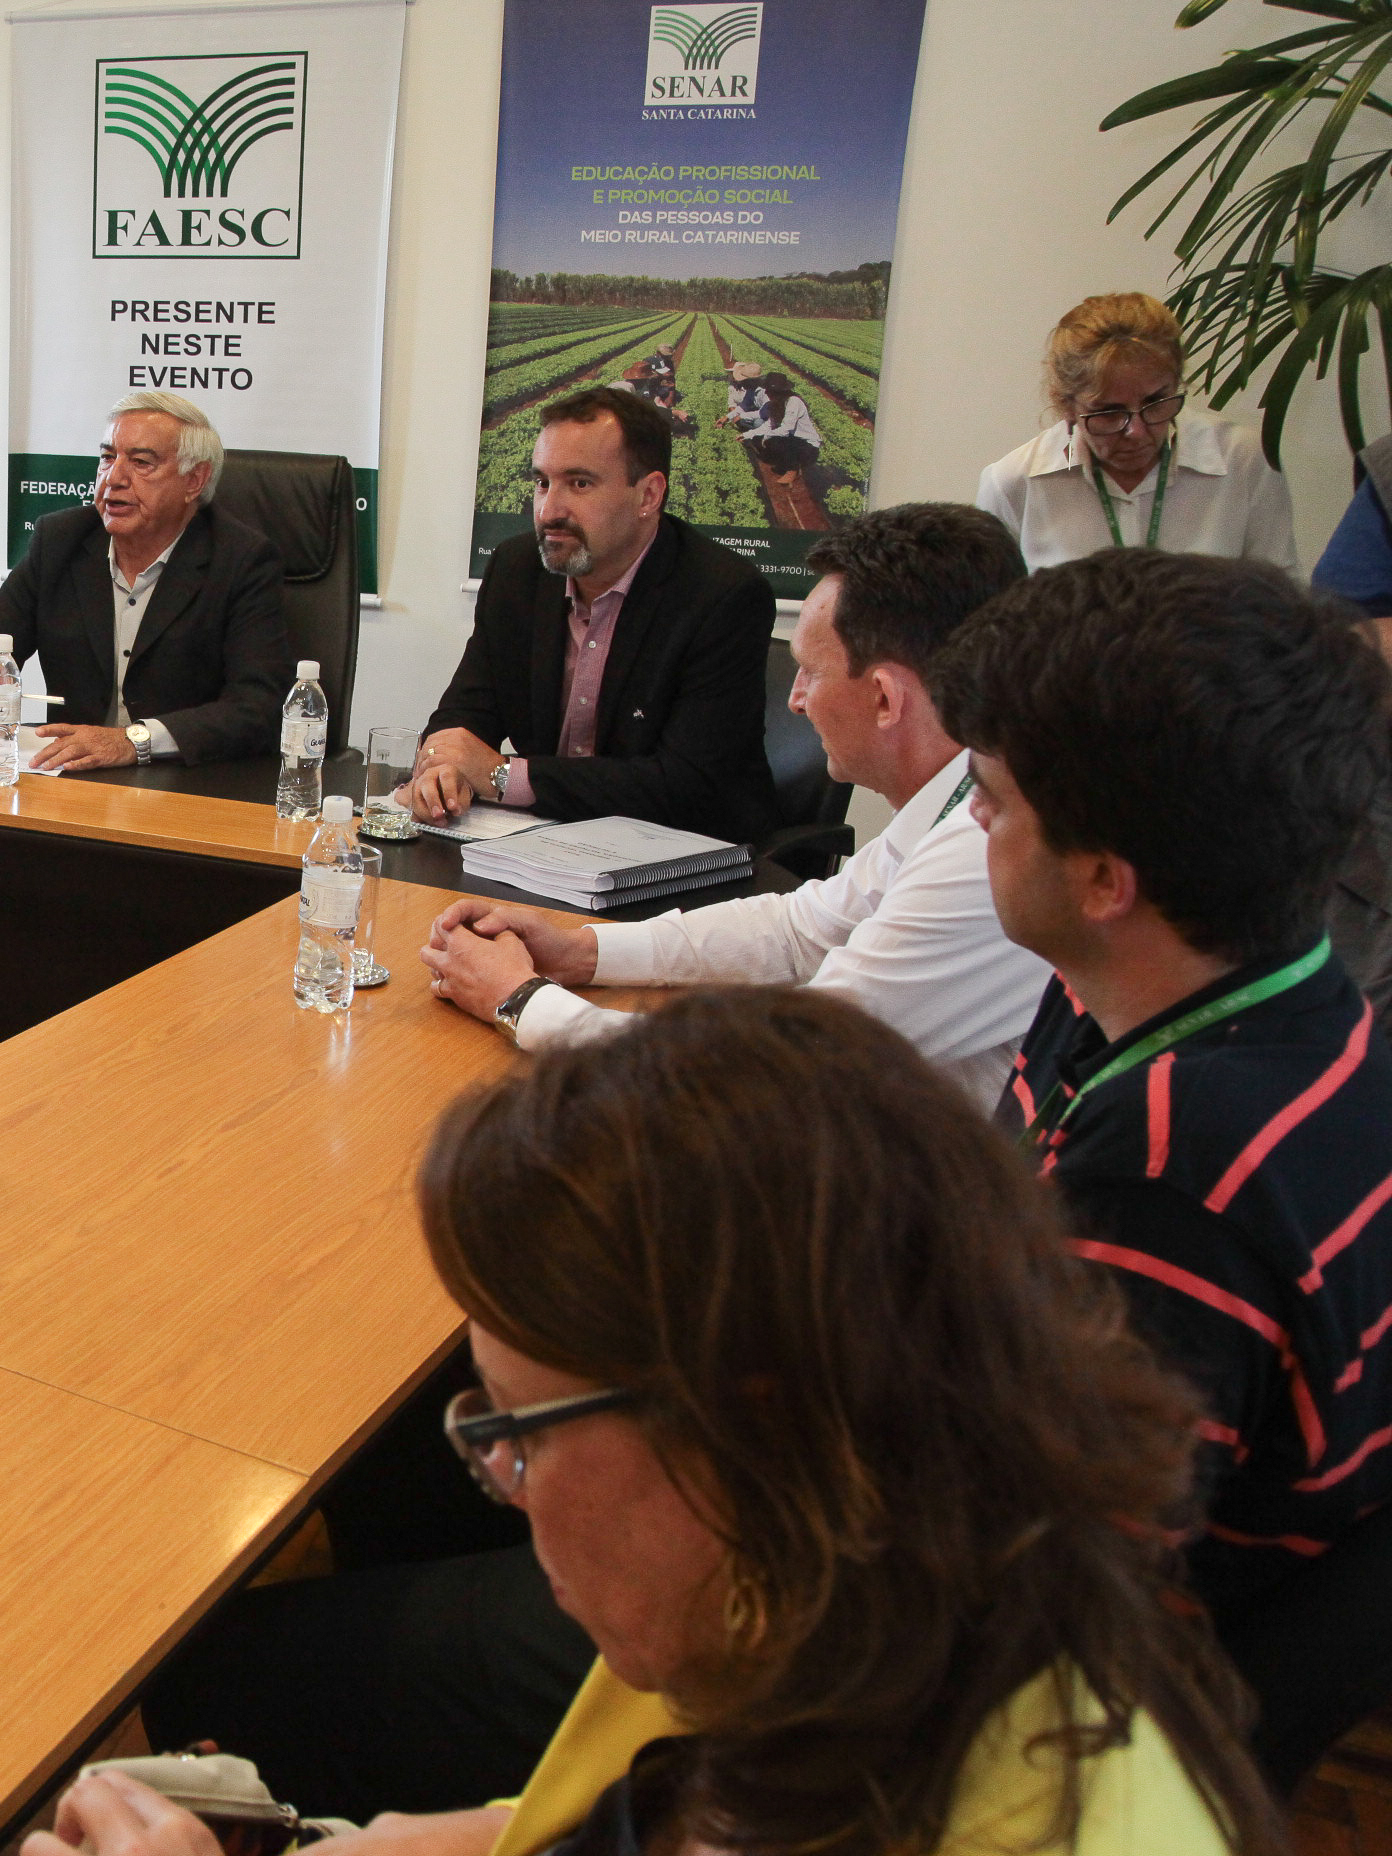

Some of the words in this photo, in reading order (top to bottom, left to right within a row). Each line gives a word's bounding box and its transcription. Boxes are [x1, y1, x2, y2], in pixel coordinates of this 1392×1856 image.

[651, 75, 749, 99] SENAR
[642, 109, 685, 120] SANTA
[687, 108, 757, 120] CATARINA
[571, 163, 675, 185] EDUCAÇÃO
[678, 165, 821, 181] PROFISSIONAL
[593, 190, 604, 204] E
[608, 186, 719, 208] PROMOÇÃO
[723, 190, 793, 205] SOCIAL
[102, 208, 291, 248] FAESC
[618, 211, 653, 224] DAS
[656, 211, 735, 225] PESSOAS
[737, 212, 764, 225] DO
[581, 230, 623, 244] MEIO
[625, 231, 679, 244] RURAL
[682, 231, 800, 245] CATARINENSE
[110, 300, 276, 324] PRESENTE
[140, 333, 242, 357] NESTE
[128, 366, 253, 391] EVENTO
[20, 481, 96, 499] FEDERAÇÃ
[743, 539, 771, 548] RURAL
[760, 564, 802, 575] 3331-9700
